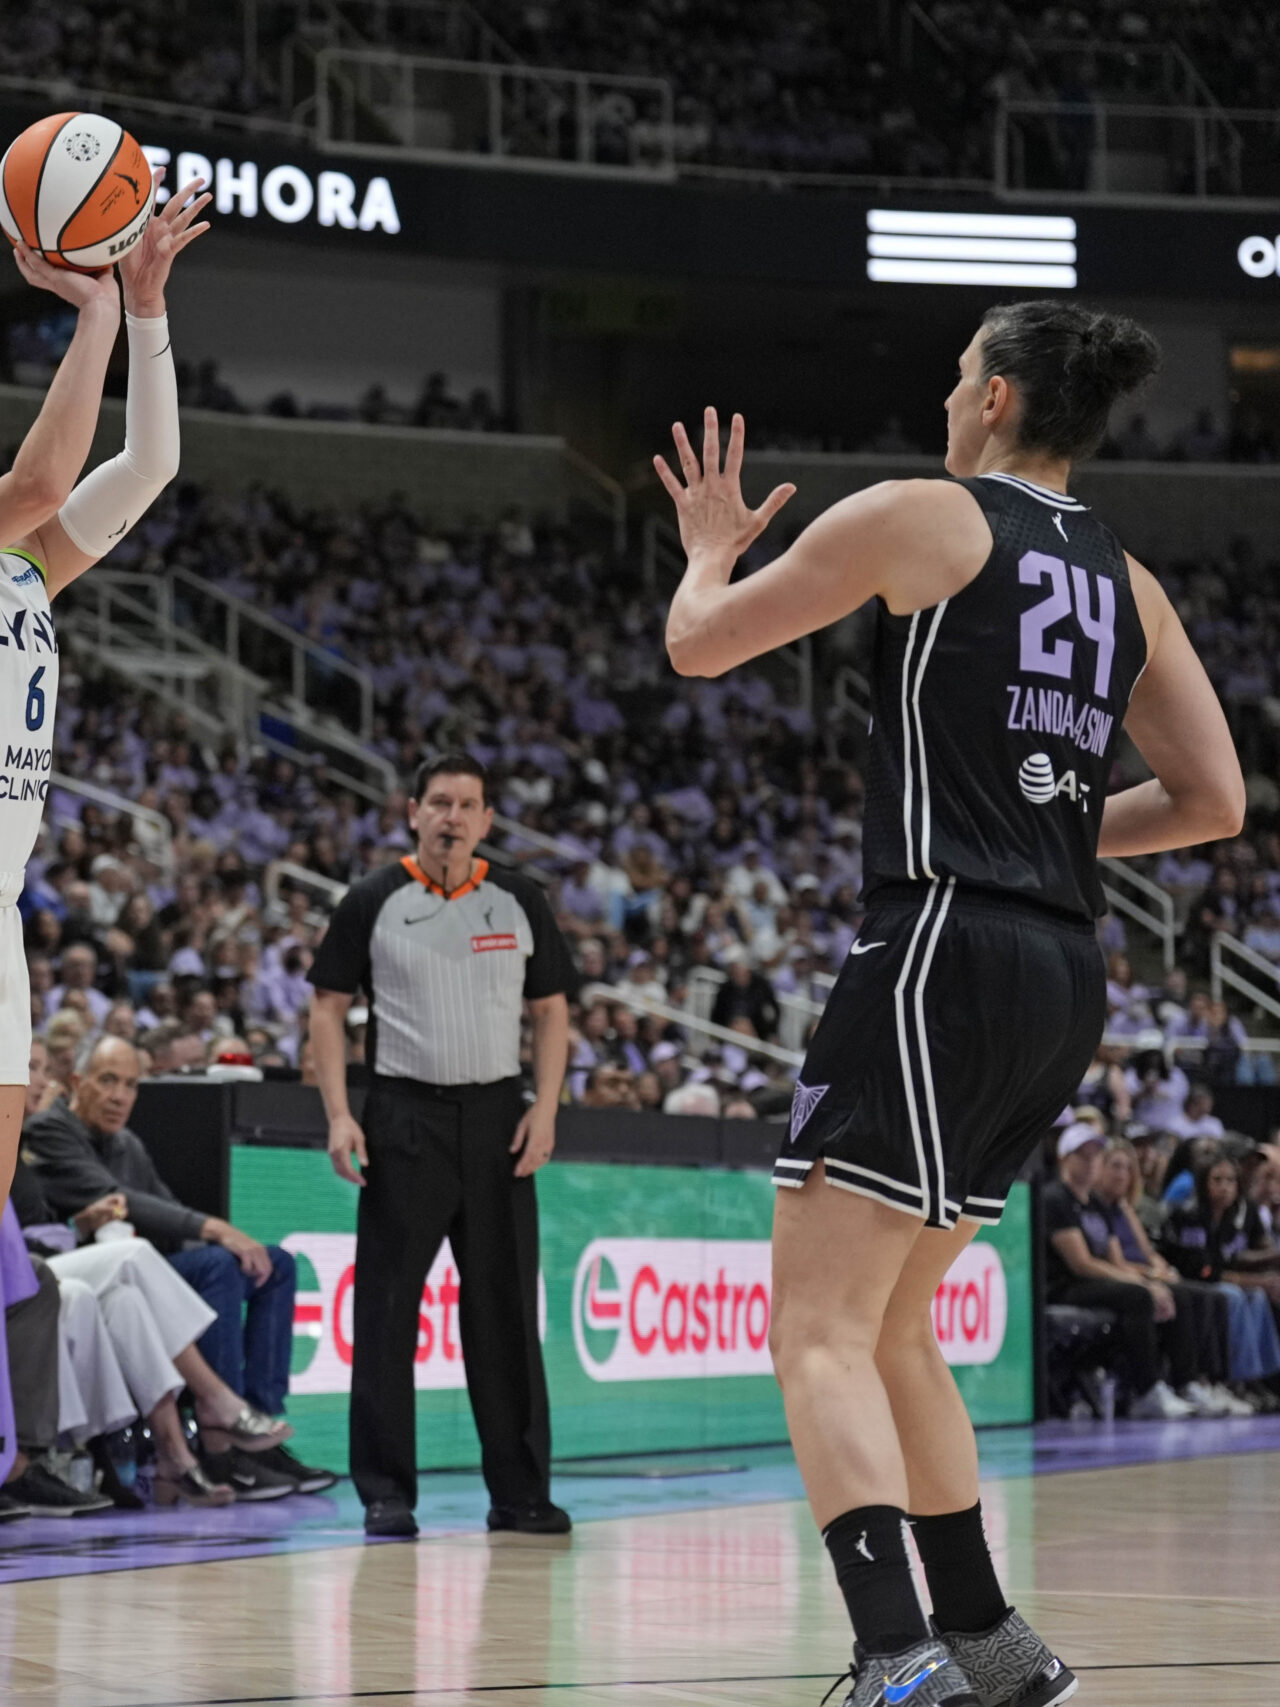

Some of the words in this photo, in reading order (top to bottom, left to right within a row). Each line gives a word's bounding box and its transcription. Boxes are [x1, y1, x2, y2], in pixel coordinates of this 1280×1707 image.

[140, 145, 401, 234] EPHORA
[1019, 550, 1115, 699] 24
[25, 666, 45, 731] 6
[4, 744, 52, 771] MAYO
[629, 1263, 773, 1357] Castro
